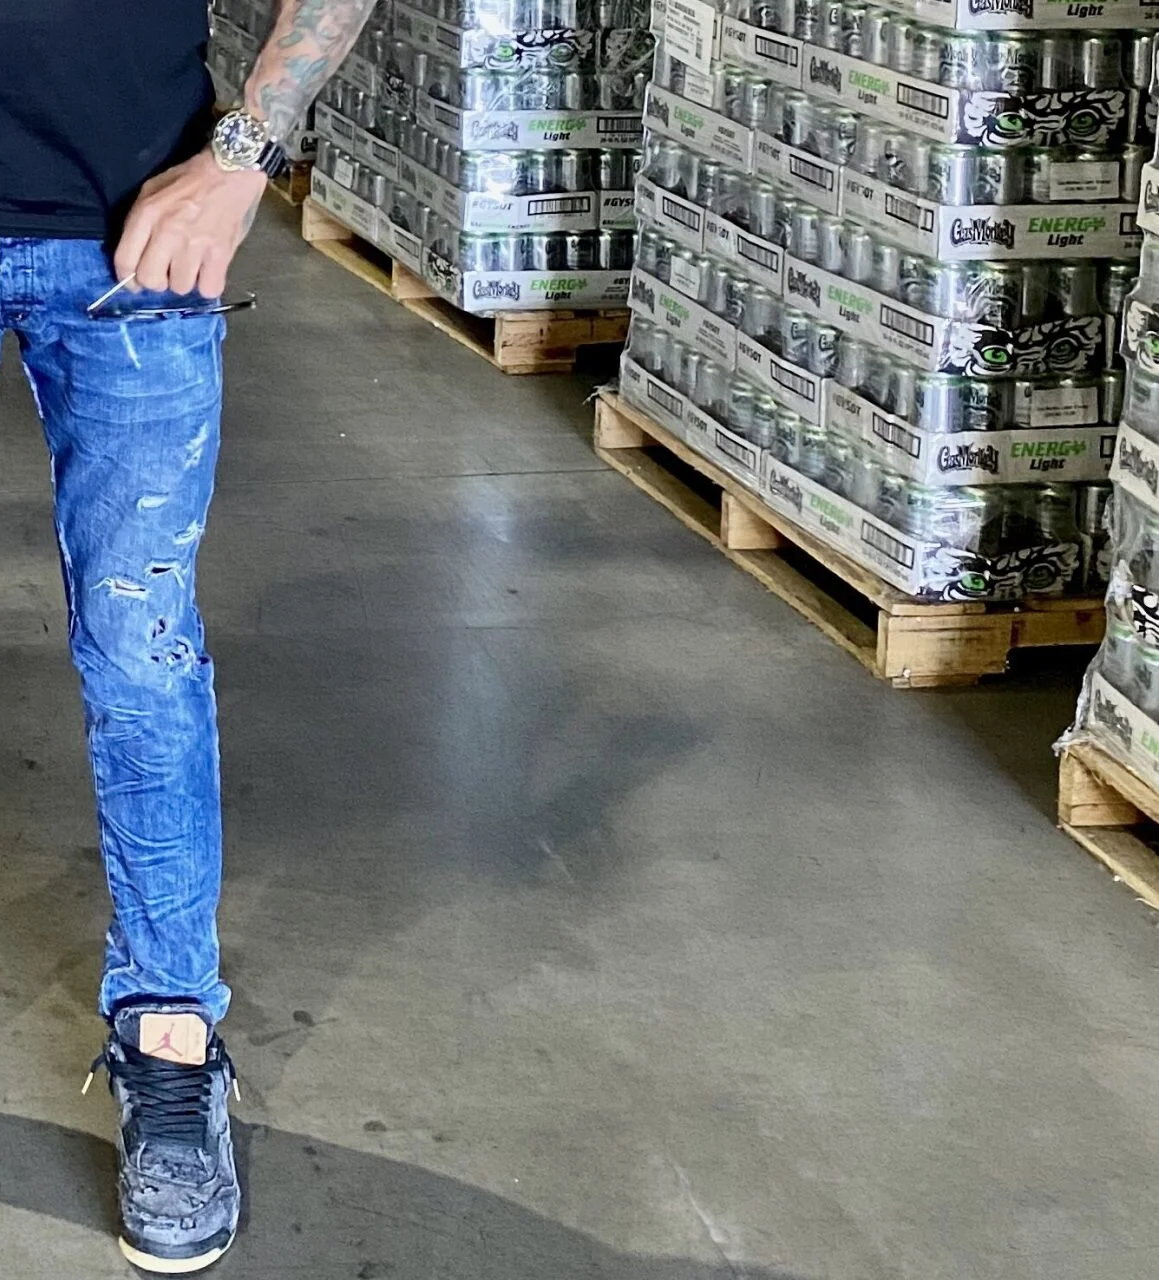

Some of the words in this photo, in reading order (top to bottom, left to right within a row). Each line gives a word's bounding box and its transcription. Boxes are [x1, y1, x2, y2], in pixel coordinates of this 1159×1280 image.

[1067, 4, 1104, 18] Light
[528, 119, 587, 131] ENERGY
[544, 132, 571, 141] Light
[604, 198, 635, 207] #GYS
[1028, 217, 1106, 233] ENERGY
[1047, 234, 1085, 248] Light
[530, 278, 588, 291] ENERGY
[545, 291, 572, 300] Light
[1010, 440, 1086, 458] ENERGY
[1030, 458, 1066, 471] Light
